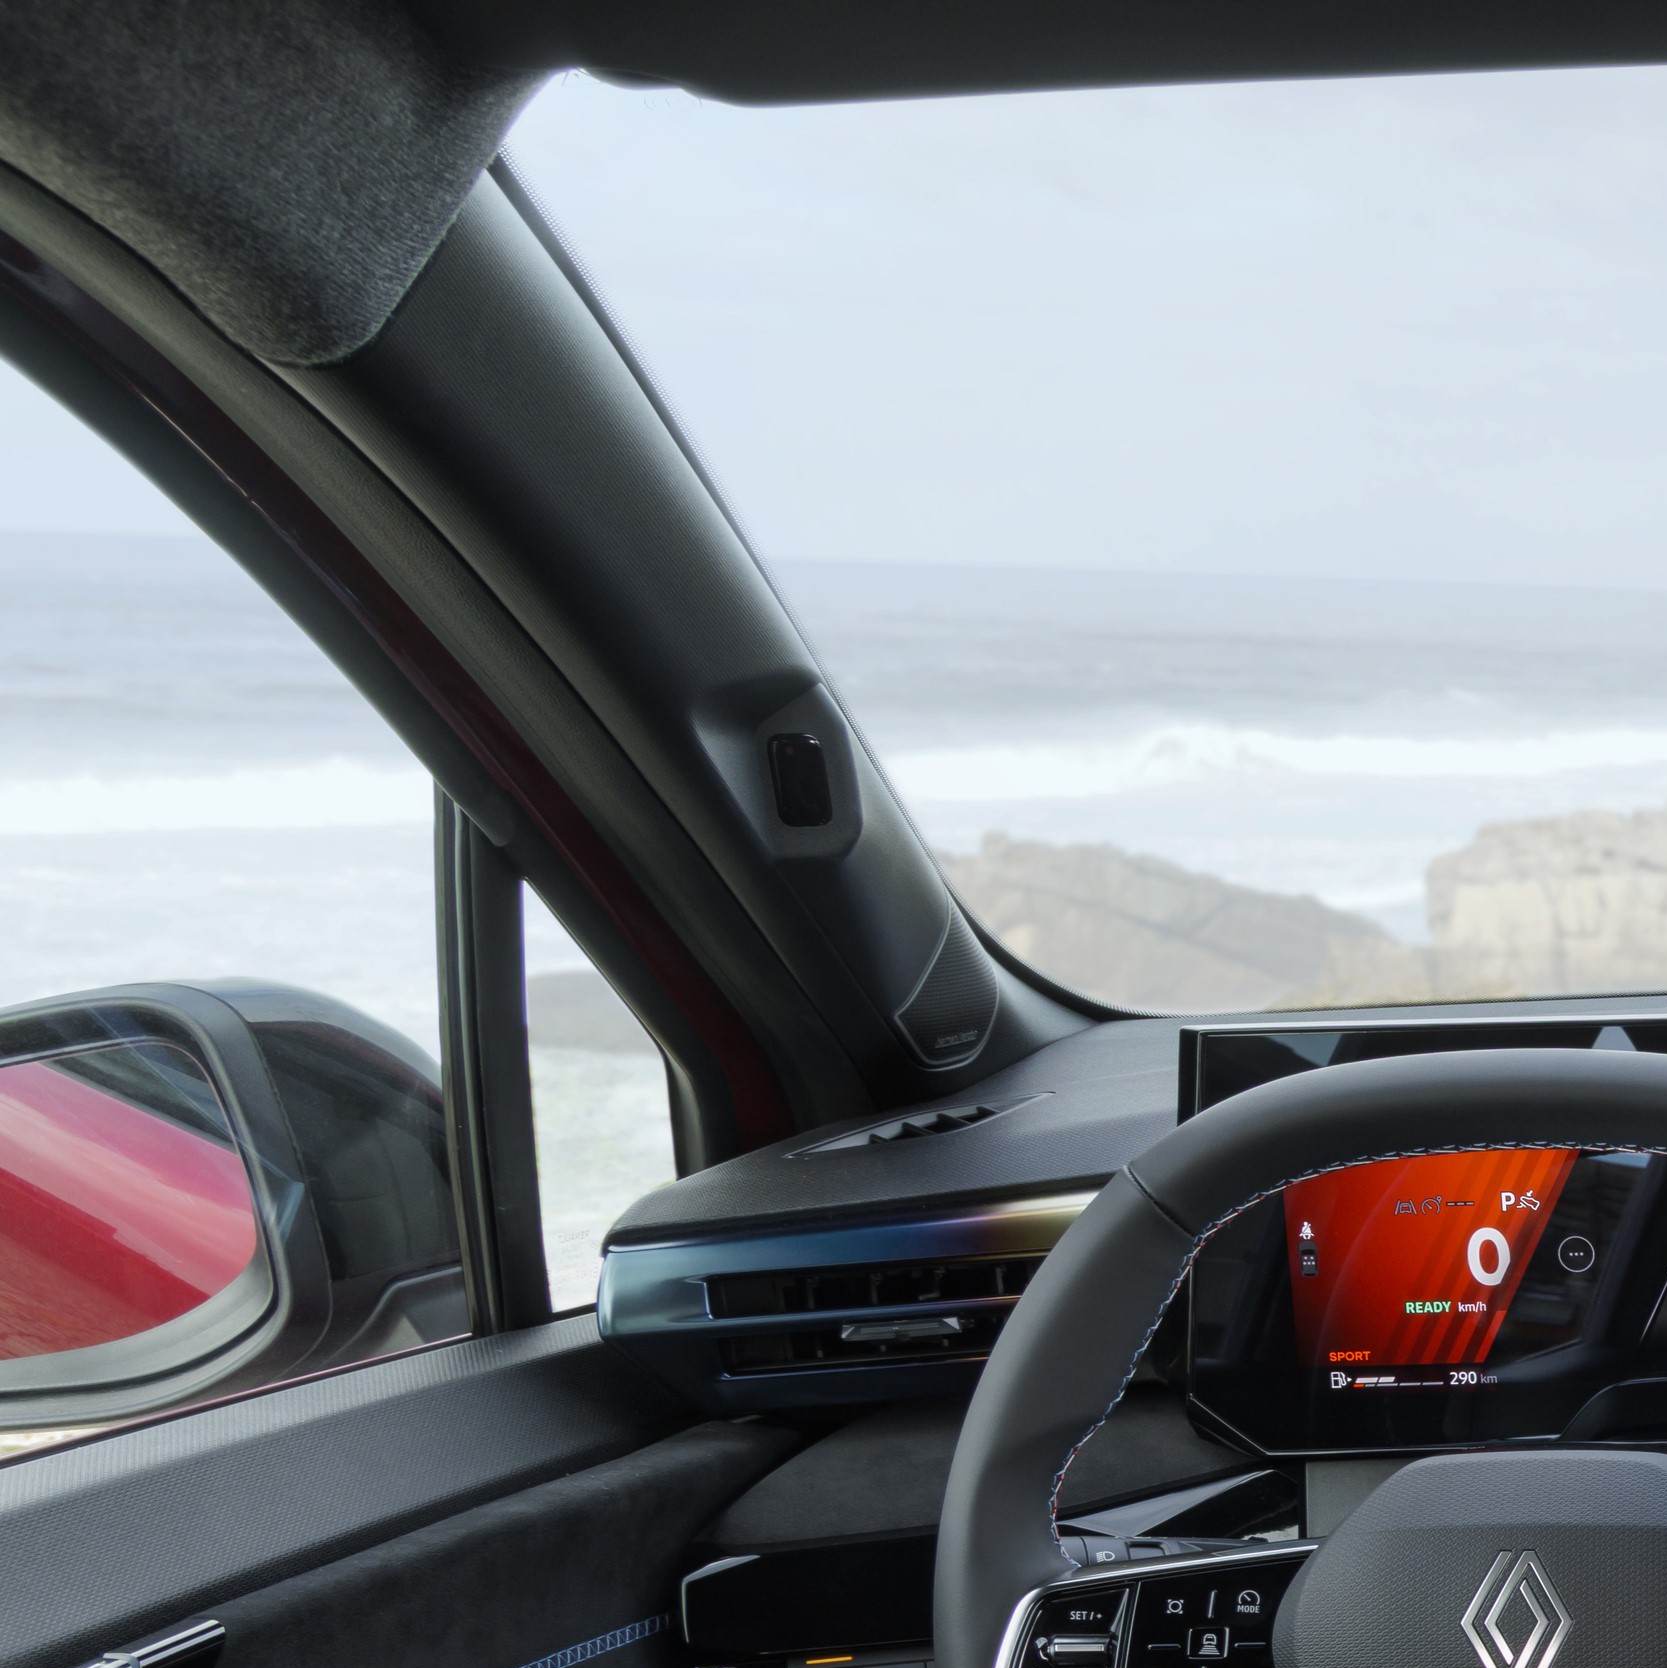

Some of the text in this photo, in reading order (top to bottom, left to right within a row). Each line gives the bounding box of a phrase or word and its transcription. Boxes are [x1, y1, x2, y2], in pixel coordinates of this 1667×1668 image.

[1501, 1191, 1516, 1212] P
[1467, 1227, 1511, 1287] 0
[1405, 1301, 1487, 1314] READY km/h
[1329, 1351, 1371, 1361] SPORT
[1449, 1371, 1498, 1385] 290 km
[1070, 1610, 1088, 1620] SET
[1237, 1605, 1260, 1613] MODE
